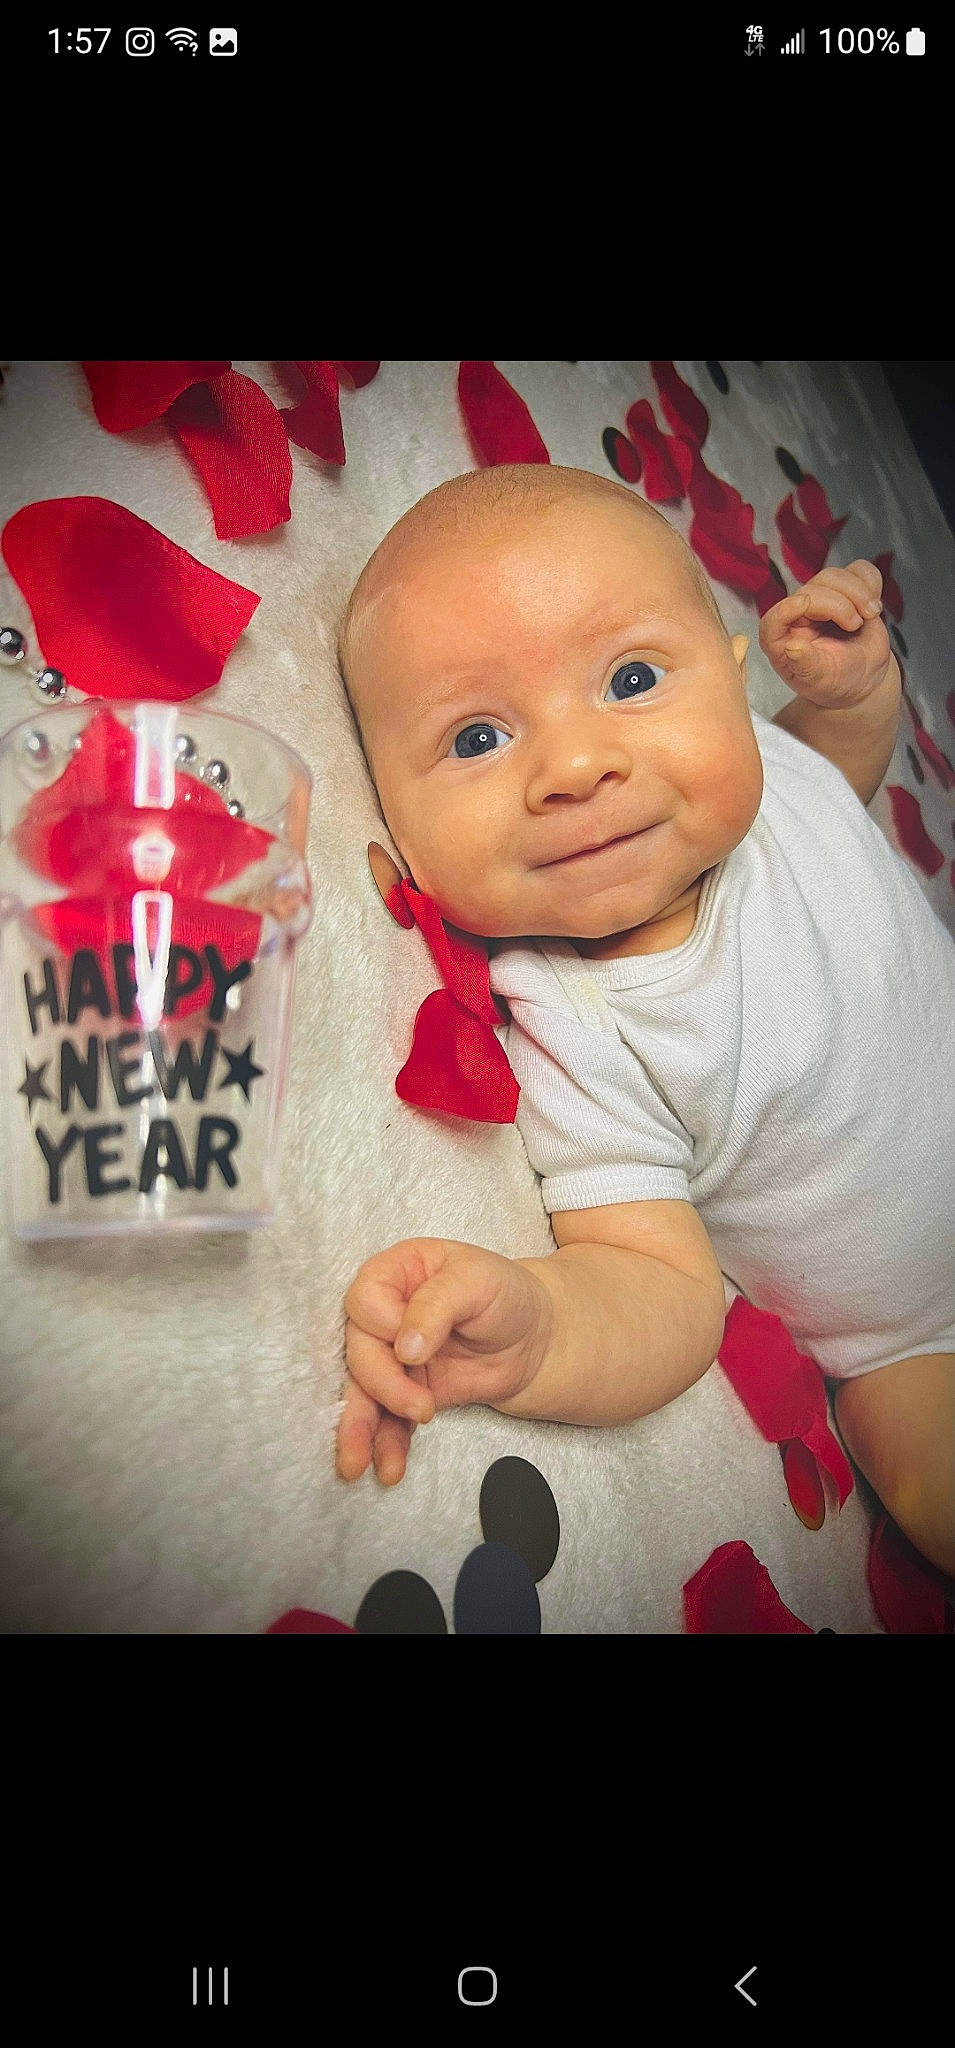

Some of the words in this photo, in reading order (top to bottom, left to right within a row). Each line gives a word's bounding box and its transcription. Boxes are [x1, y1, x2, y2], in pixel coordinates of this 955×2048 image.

[23, 943, 252, 1036] HAPPY
[60, 1029, 219, 1115] NEW
[35, 1115, 240, 1205] YEAR
